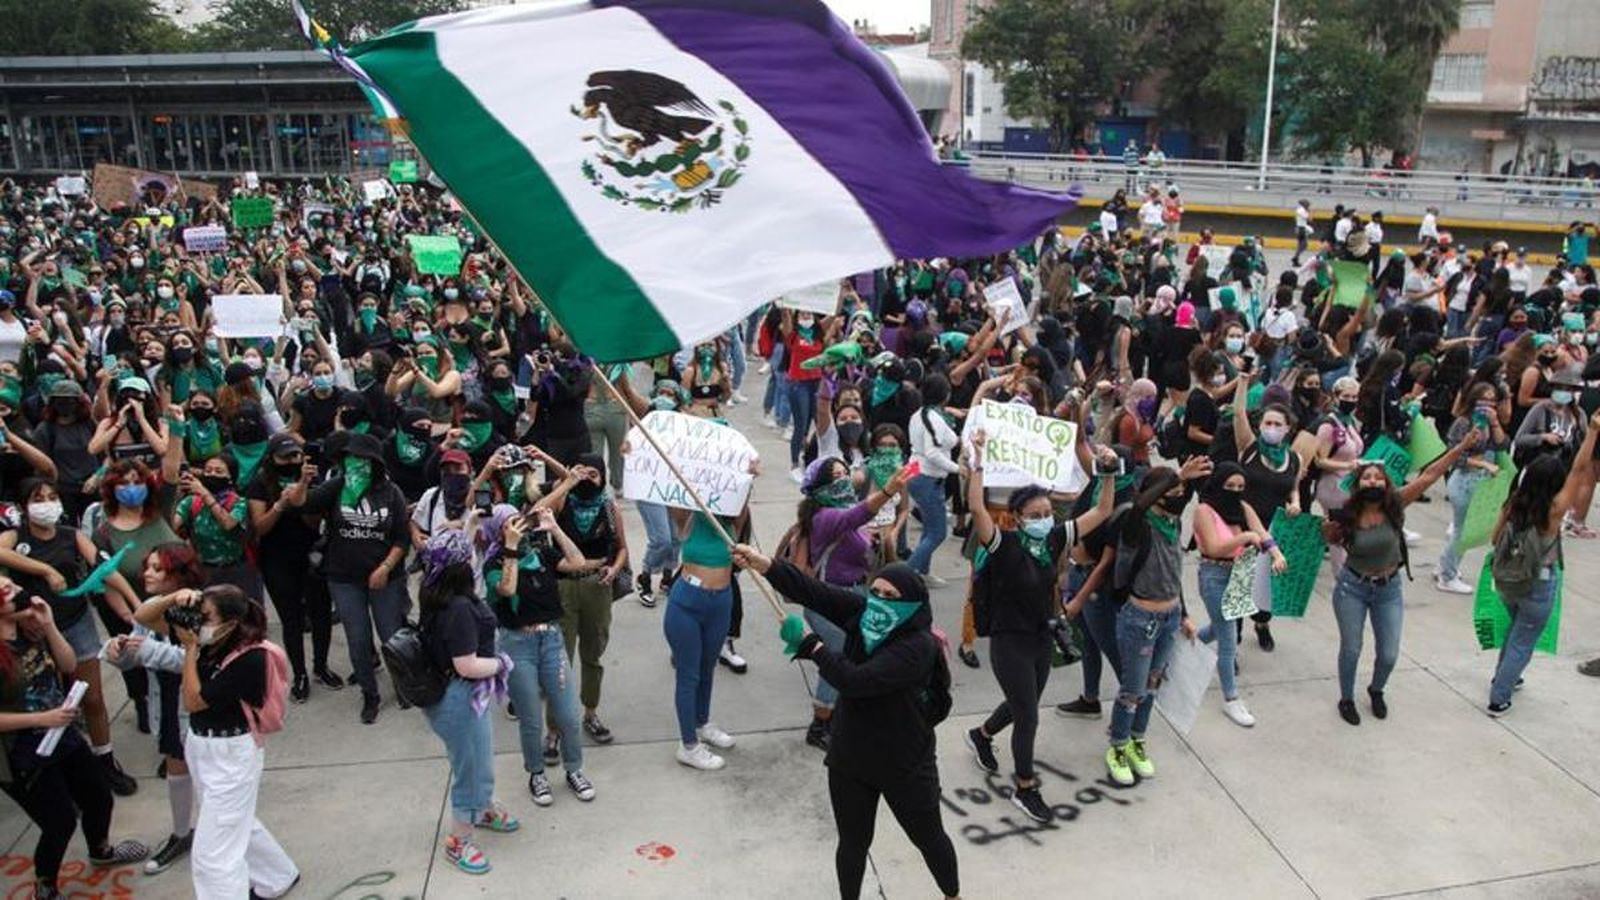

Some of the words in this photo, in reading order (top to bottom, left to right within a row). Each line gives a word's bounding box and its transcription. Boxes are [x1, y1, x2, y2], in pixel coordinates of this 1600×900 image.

[986, 402, 1044, 434] EXISTO
[339, 526, 385, 541] adidas
[961, 764, 1152, 846] aboto
